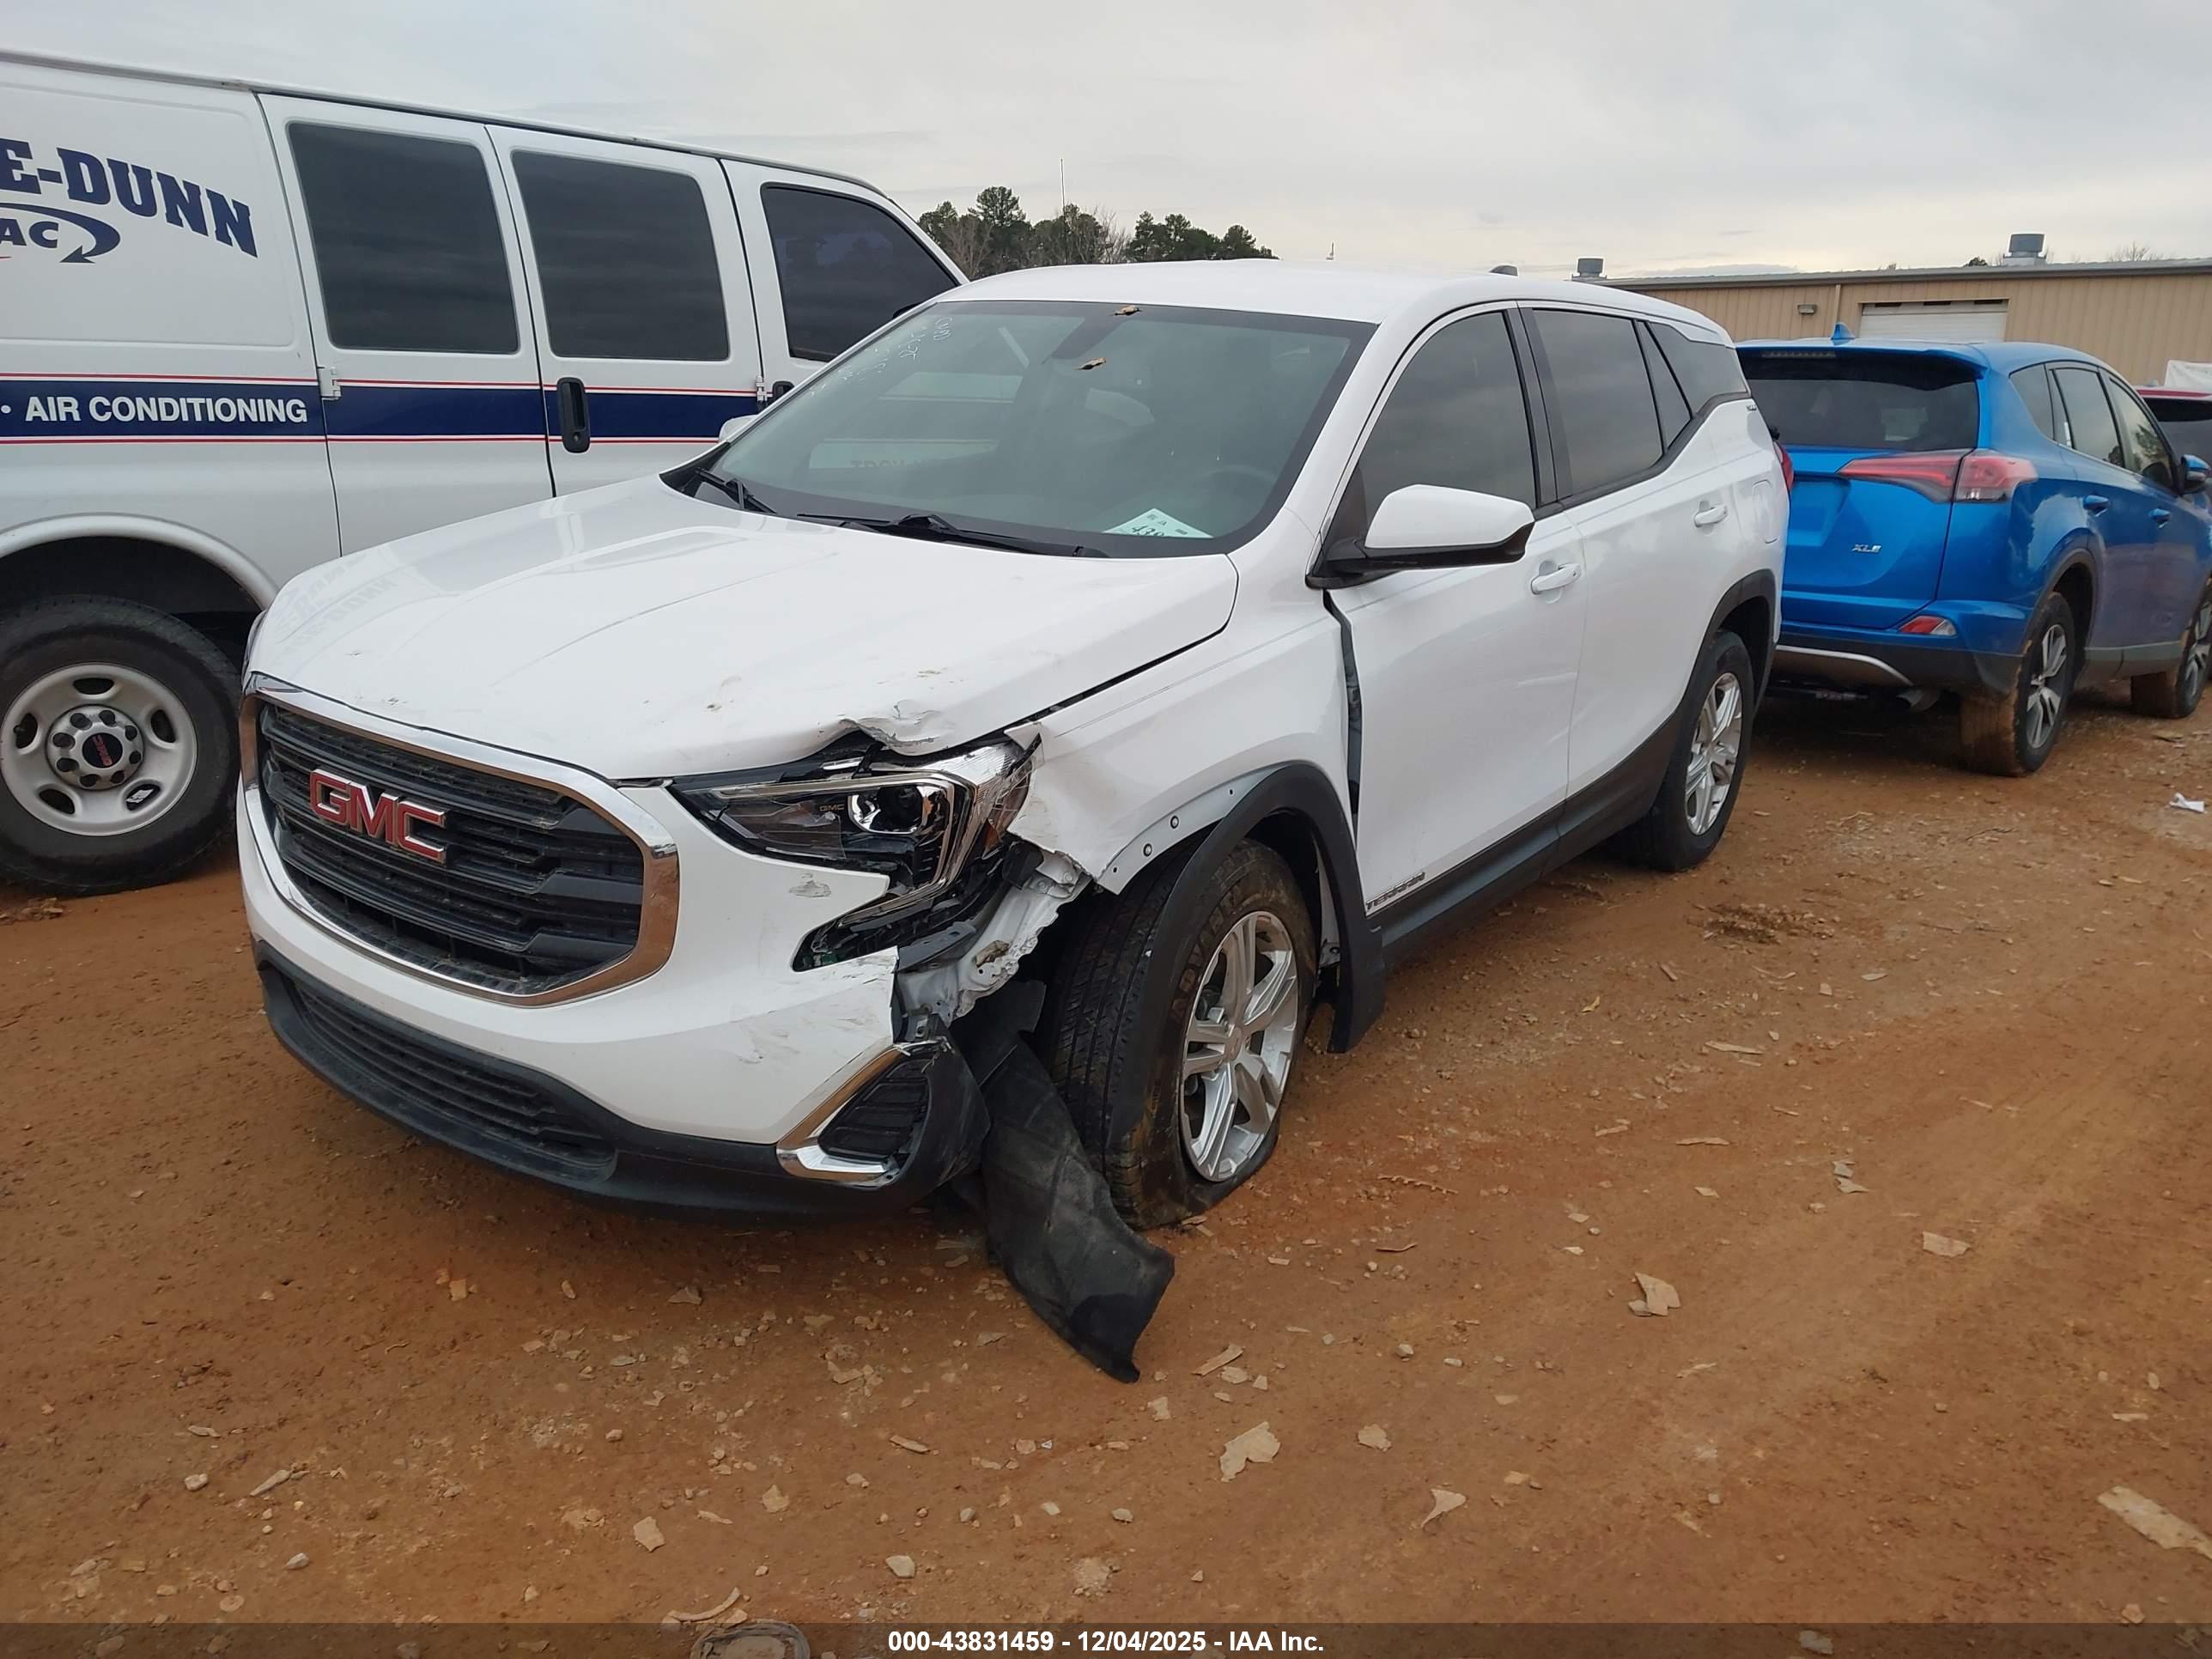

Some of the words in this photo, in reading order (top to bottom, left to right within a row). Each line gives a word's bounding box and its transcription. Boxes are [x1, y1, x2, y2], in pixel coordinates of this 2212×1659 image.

[26, 396, 81, 422] AIR
[89, 396, 307, 422] CONDITIONING
[310, 769, 447, 865] GMC
